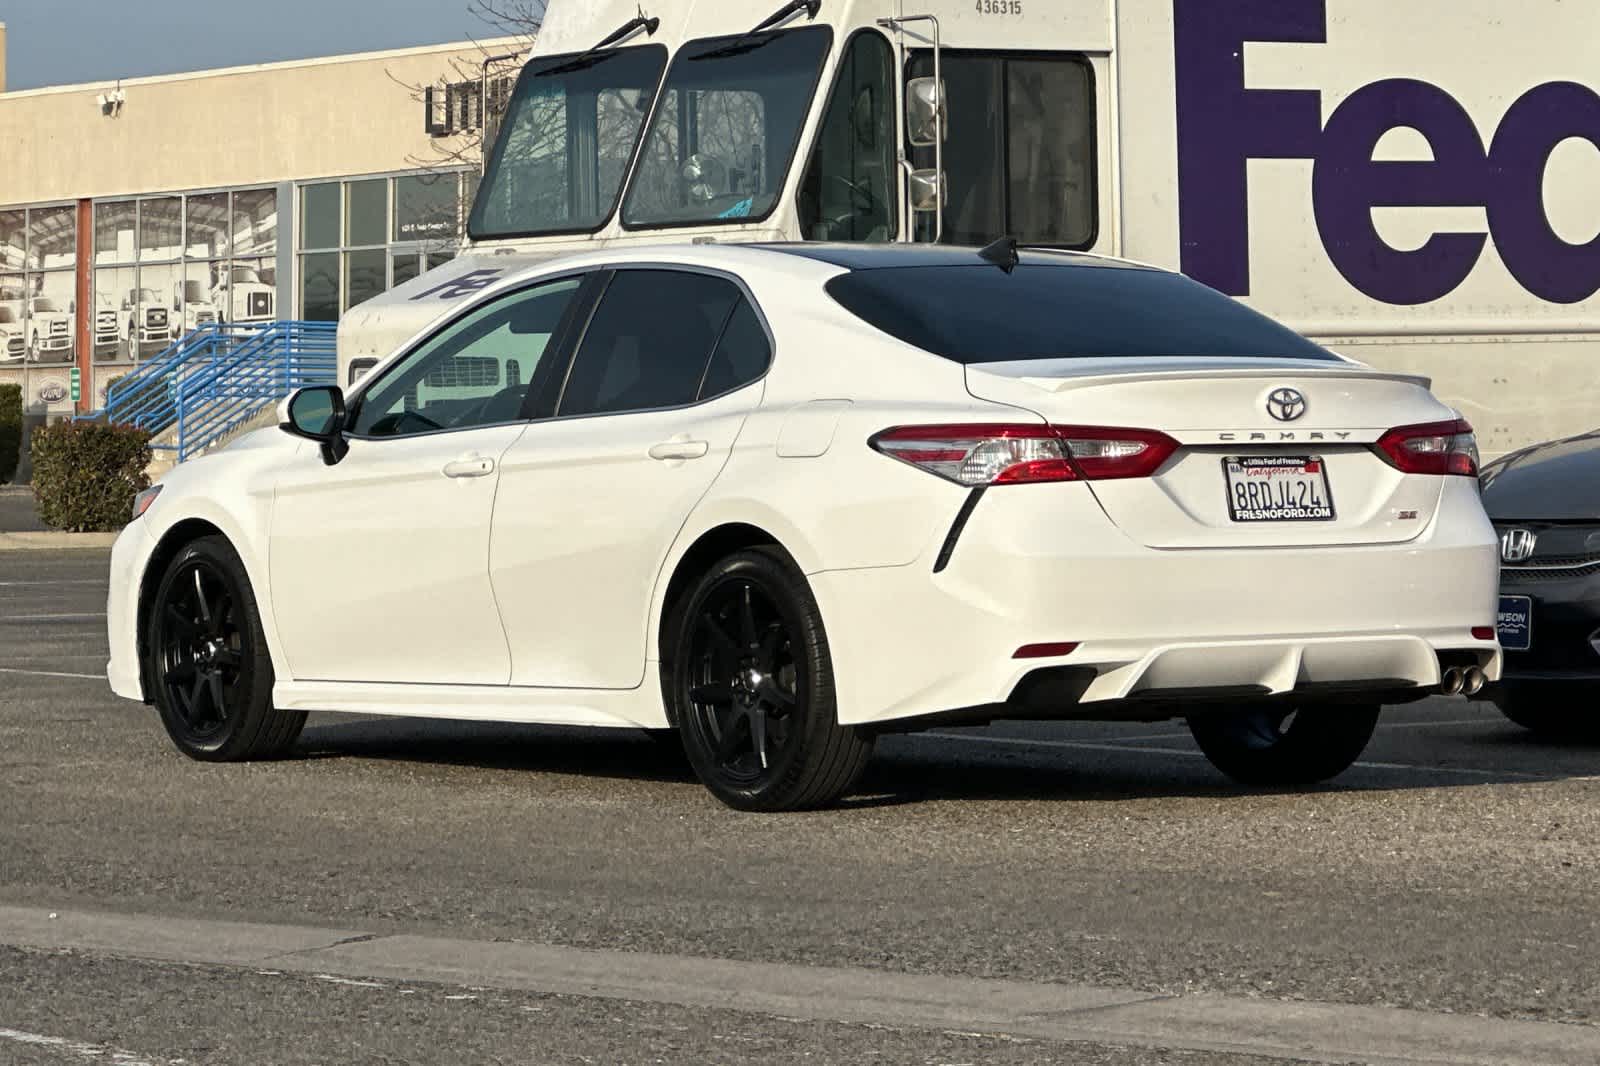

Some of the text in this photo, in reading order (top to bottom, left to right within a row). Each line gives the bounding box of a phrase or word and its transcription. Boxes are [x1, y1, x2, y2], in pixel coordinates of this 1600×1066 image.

[976, 0, 1021, 14] 436315
[1219, 432, 1351, 440] CAMRY
[1235, 480, 1321, 510] 8RDJ424
[1236, 507, 1331, 519] FRESNOFORD.COM
